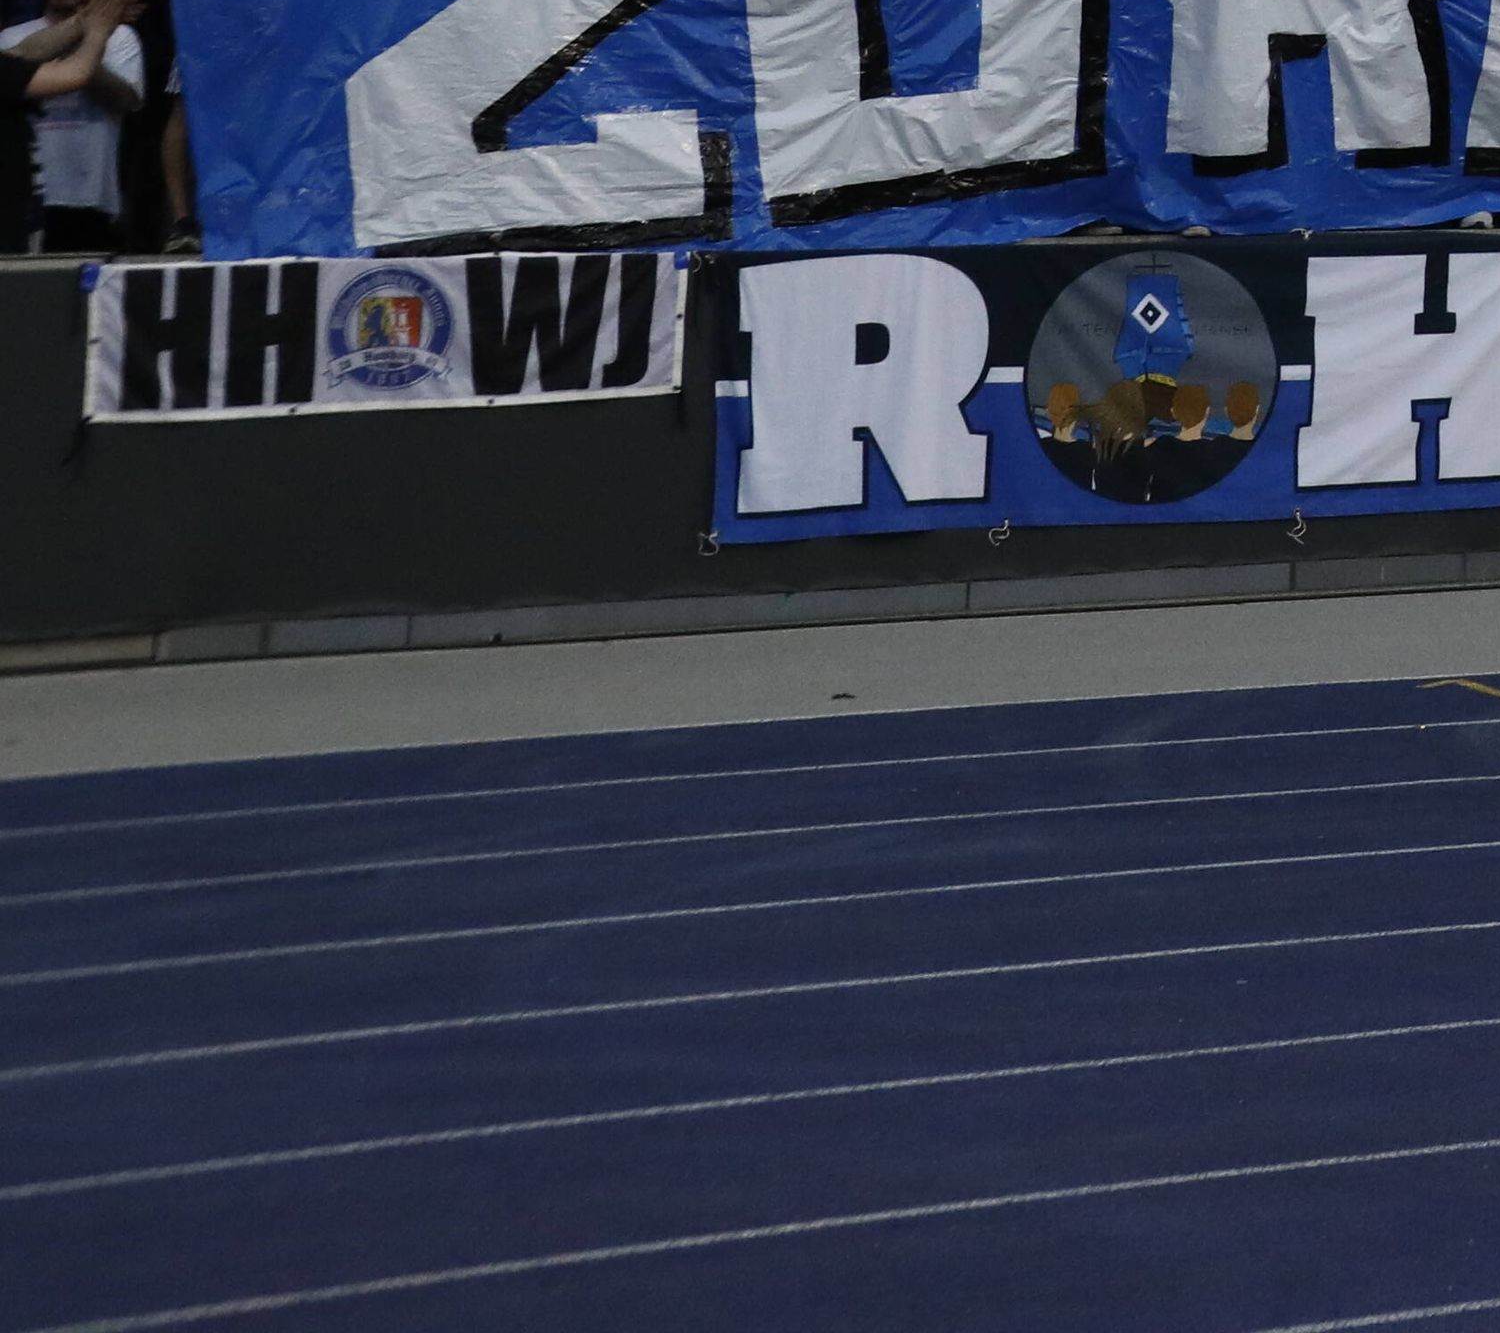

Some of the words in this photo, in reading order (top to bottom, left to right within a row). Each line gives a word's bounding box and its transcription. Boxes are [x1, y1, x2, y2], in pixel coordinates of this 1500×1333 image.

[122, 261, 319, 411] HH
[466, 256, 657, 397] WJ
[737, 253, 991, 515] R
